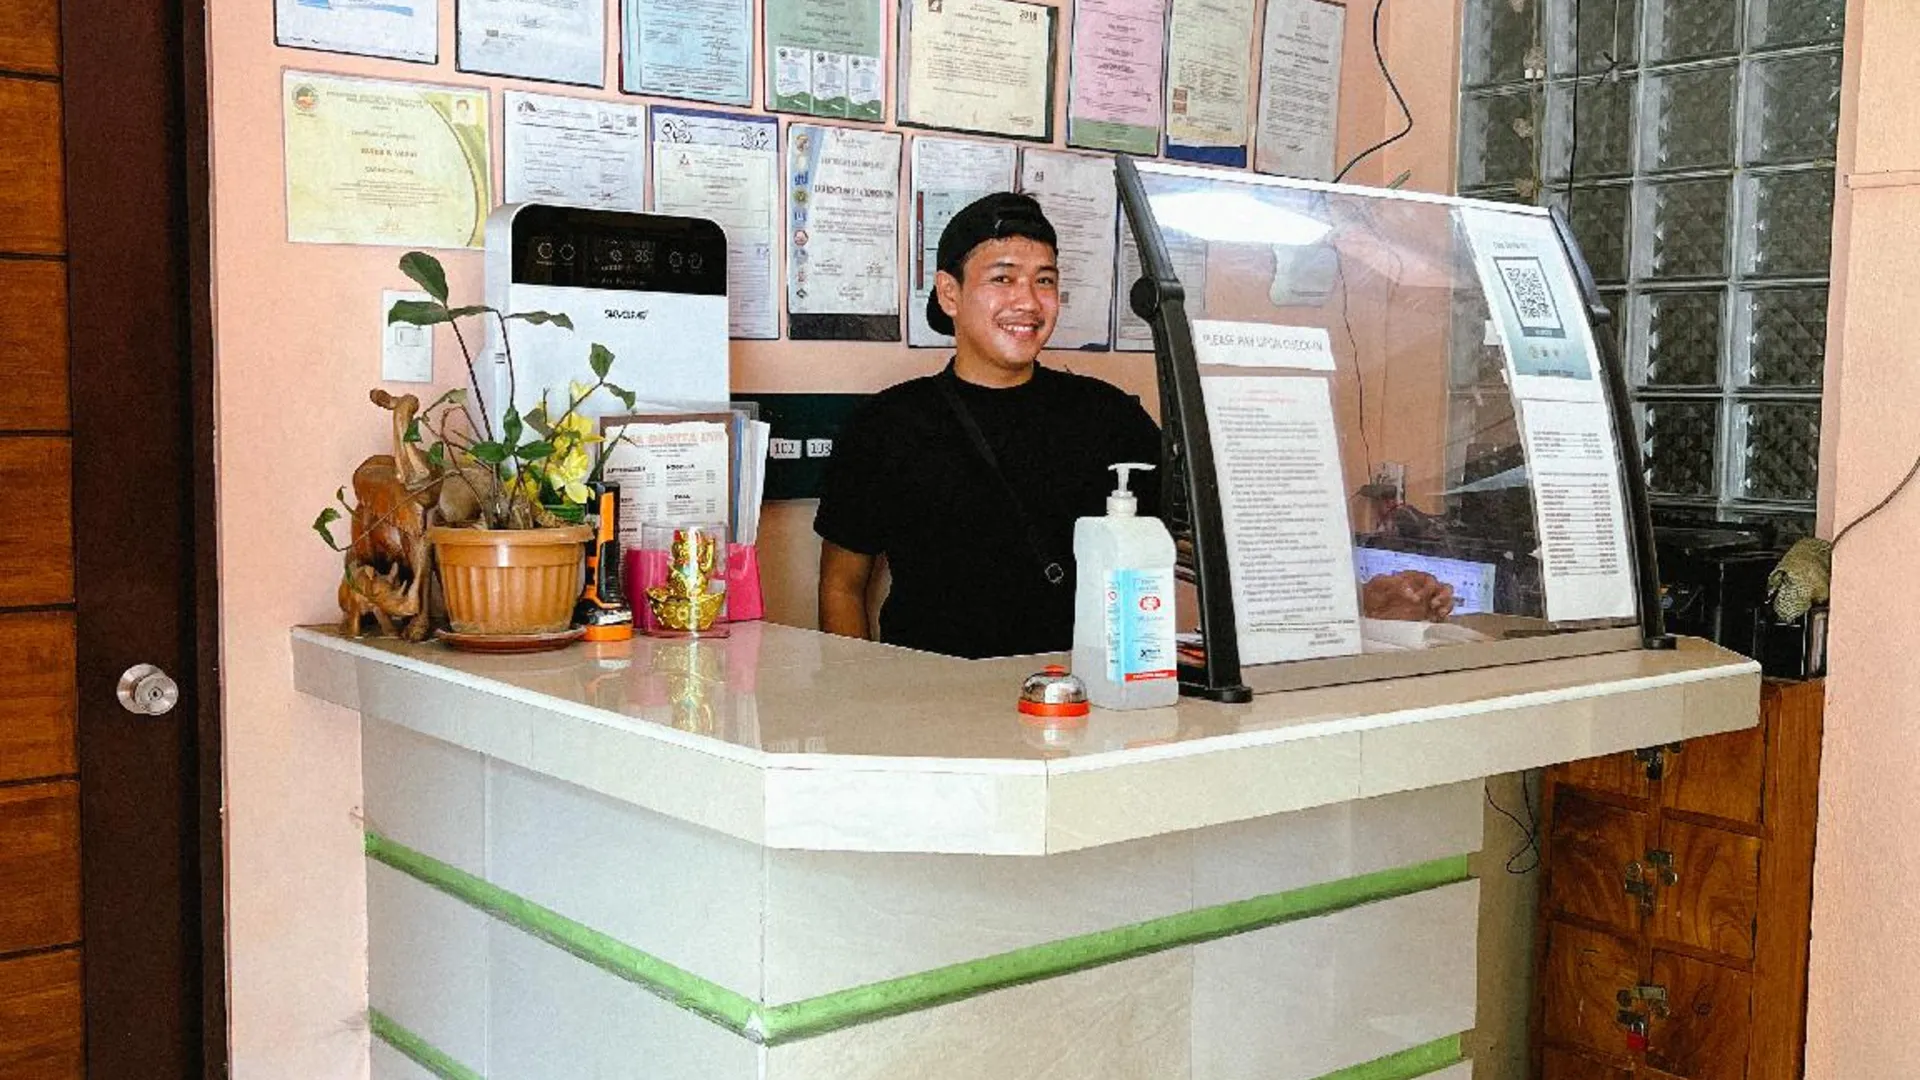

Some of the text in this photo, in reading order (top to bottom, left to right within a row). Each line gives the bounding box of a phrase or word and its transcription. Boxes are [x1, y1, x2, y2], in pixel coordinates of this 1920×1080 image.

[1202, 333, 1234, 346] PLEASE
[1237, 335, 1255, 348] PAY
[775, 442, 795, 454] 102
